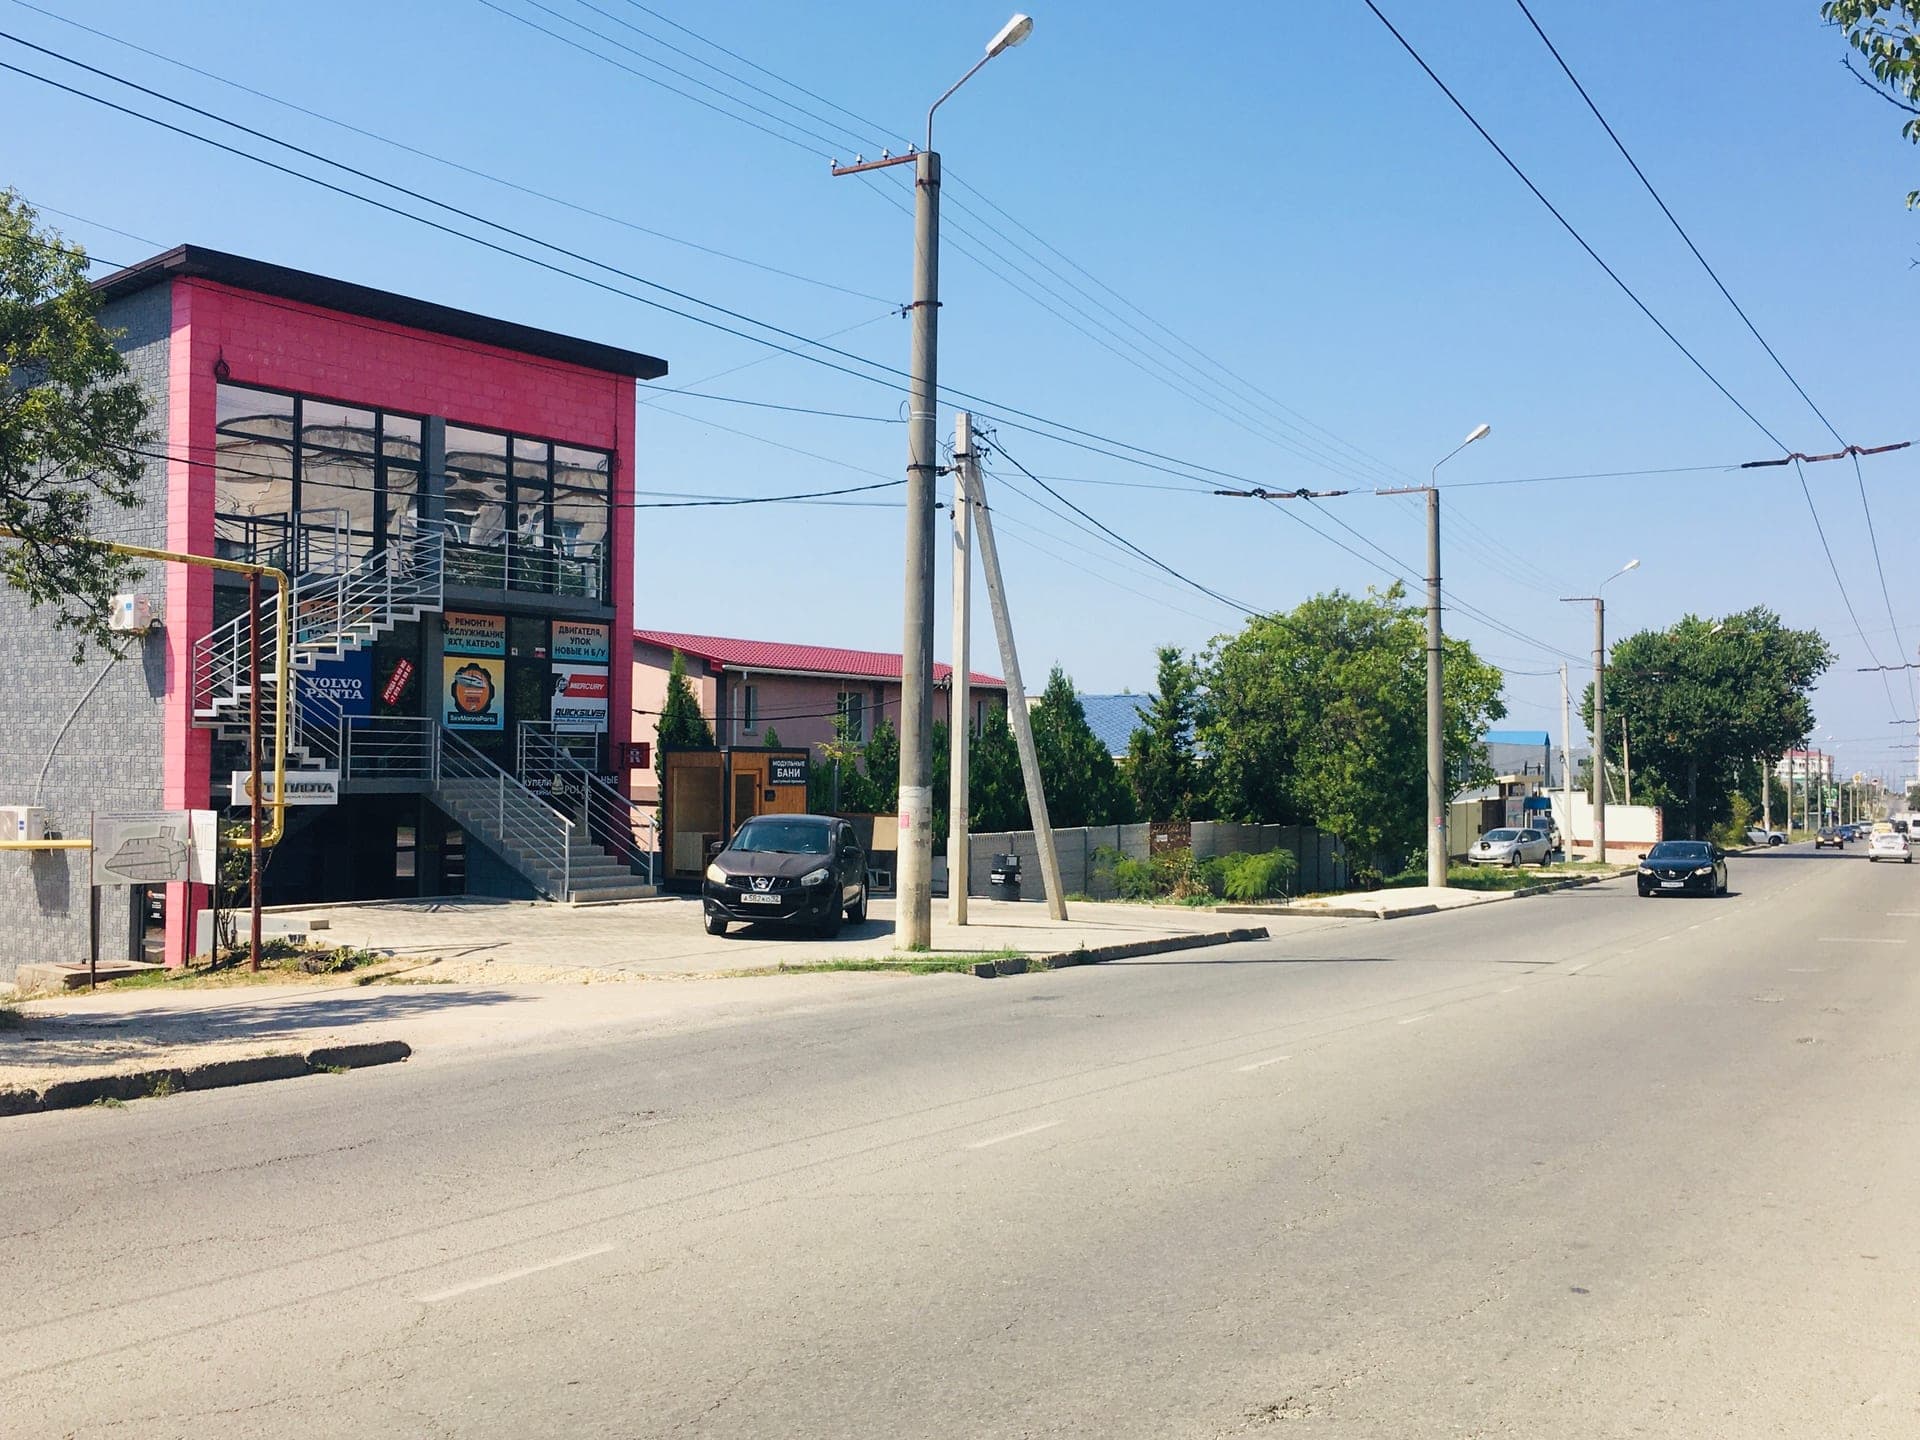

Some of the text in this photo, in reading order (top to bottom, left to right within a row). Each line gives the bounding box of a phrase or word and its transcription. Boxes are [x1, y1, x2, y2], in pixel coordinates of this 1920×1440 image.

[455, 617, 487, 627] РЕМОНТ
[558, 625, 602, 637] ДВИГАТЕЛЯ,
[448, 638, 500, 649] ЯХТ, КАТЕРОВ
[570, 637, 591, 646] УПОК
[554, 646, 582, 655] НОВЫЕ
[306, 677, 362, 688] VOLVO
[570, 682, 604, 690] MERCURY
[305, 688, 364, 699] PENTA
[555, 708, 606, 717] QUICKSILVER
[777, 768, 801, 778] БАНИ
